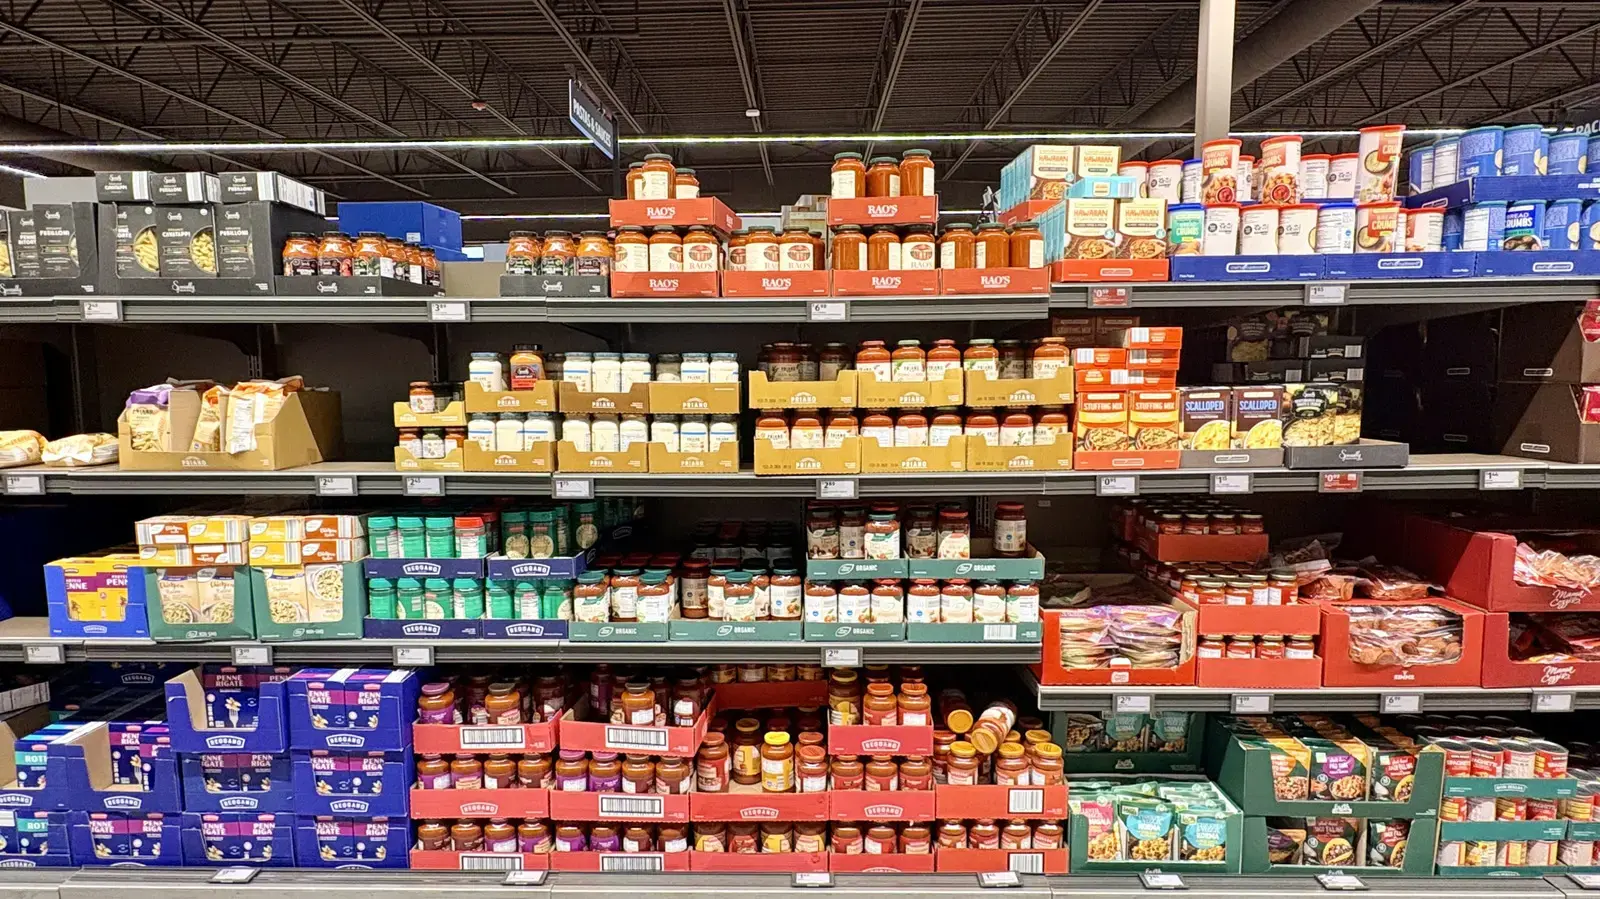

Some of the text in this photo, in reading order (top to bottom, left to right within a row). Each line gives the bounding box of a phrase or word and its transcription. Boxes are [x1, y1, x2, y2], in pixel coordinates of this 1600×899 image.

[647, 207, 676, 216] RAO'S
[868, 204, 898, 214] RAO'S
[649, 279, 679, 288] RAO'S
[762, 278, 792, 287] RAO'S
[872, 276, 902, 286] RAO'S
[981, 276, 1010, 285] RAO'S
[1186, 401, 1224, 411] SCALLOPED
[1239, 400, 1277, 410] SCALLOPED
